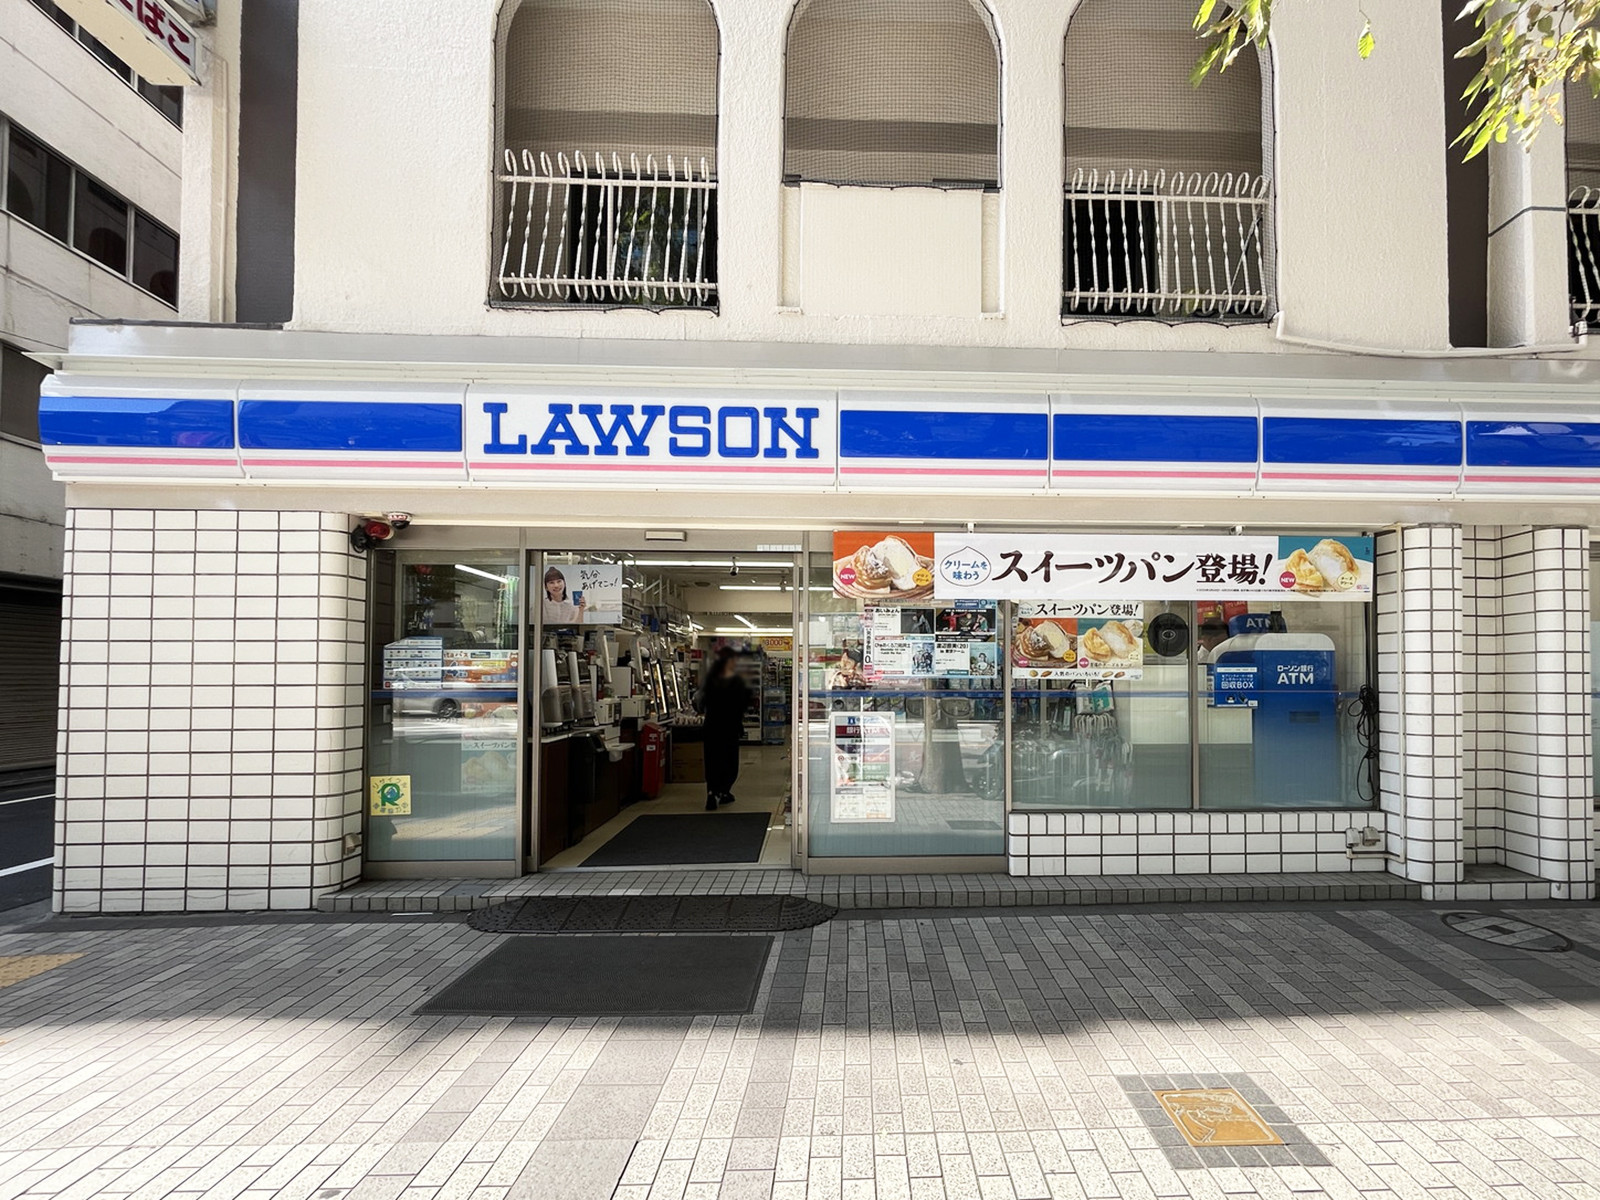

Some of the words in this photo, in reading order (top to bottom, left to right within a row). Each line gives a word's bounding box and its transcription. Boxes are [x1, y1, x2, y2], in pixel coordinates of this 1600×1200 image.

[119, 0, 191, 66] ばこ
[483, 402, 820, 459] LAWSON
[944, 560, 988, 569] クリームを
[992, 550, 1274, 585] スイーツパン登場!
[580, 569, 600, 580] 気分
[952, 571, 980, 580] 味わう
[1034, 602, 1139, 616] スイーツパン登場!
[1221, 681, 1254, 689] 回収BOX
[1277, 672, 1314, 685] ATM
